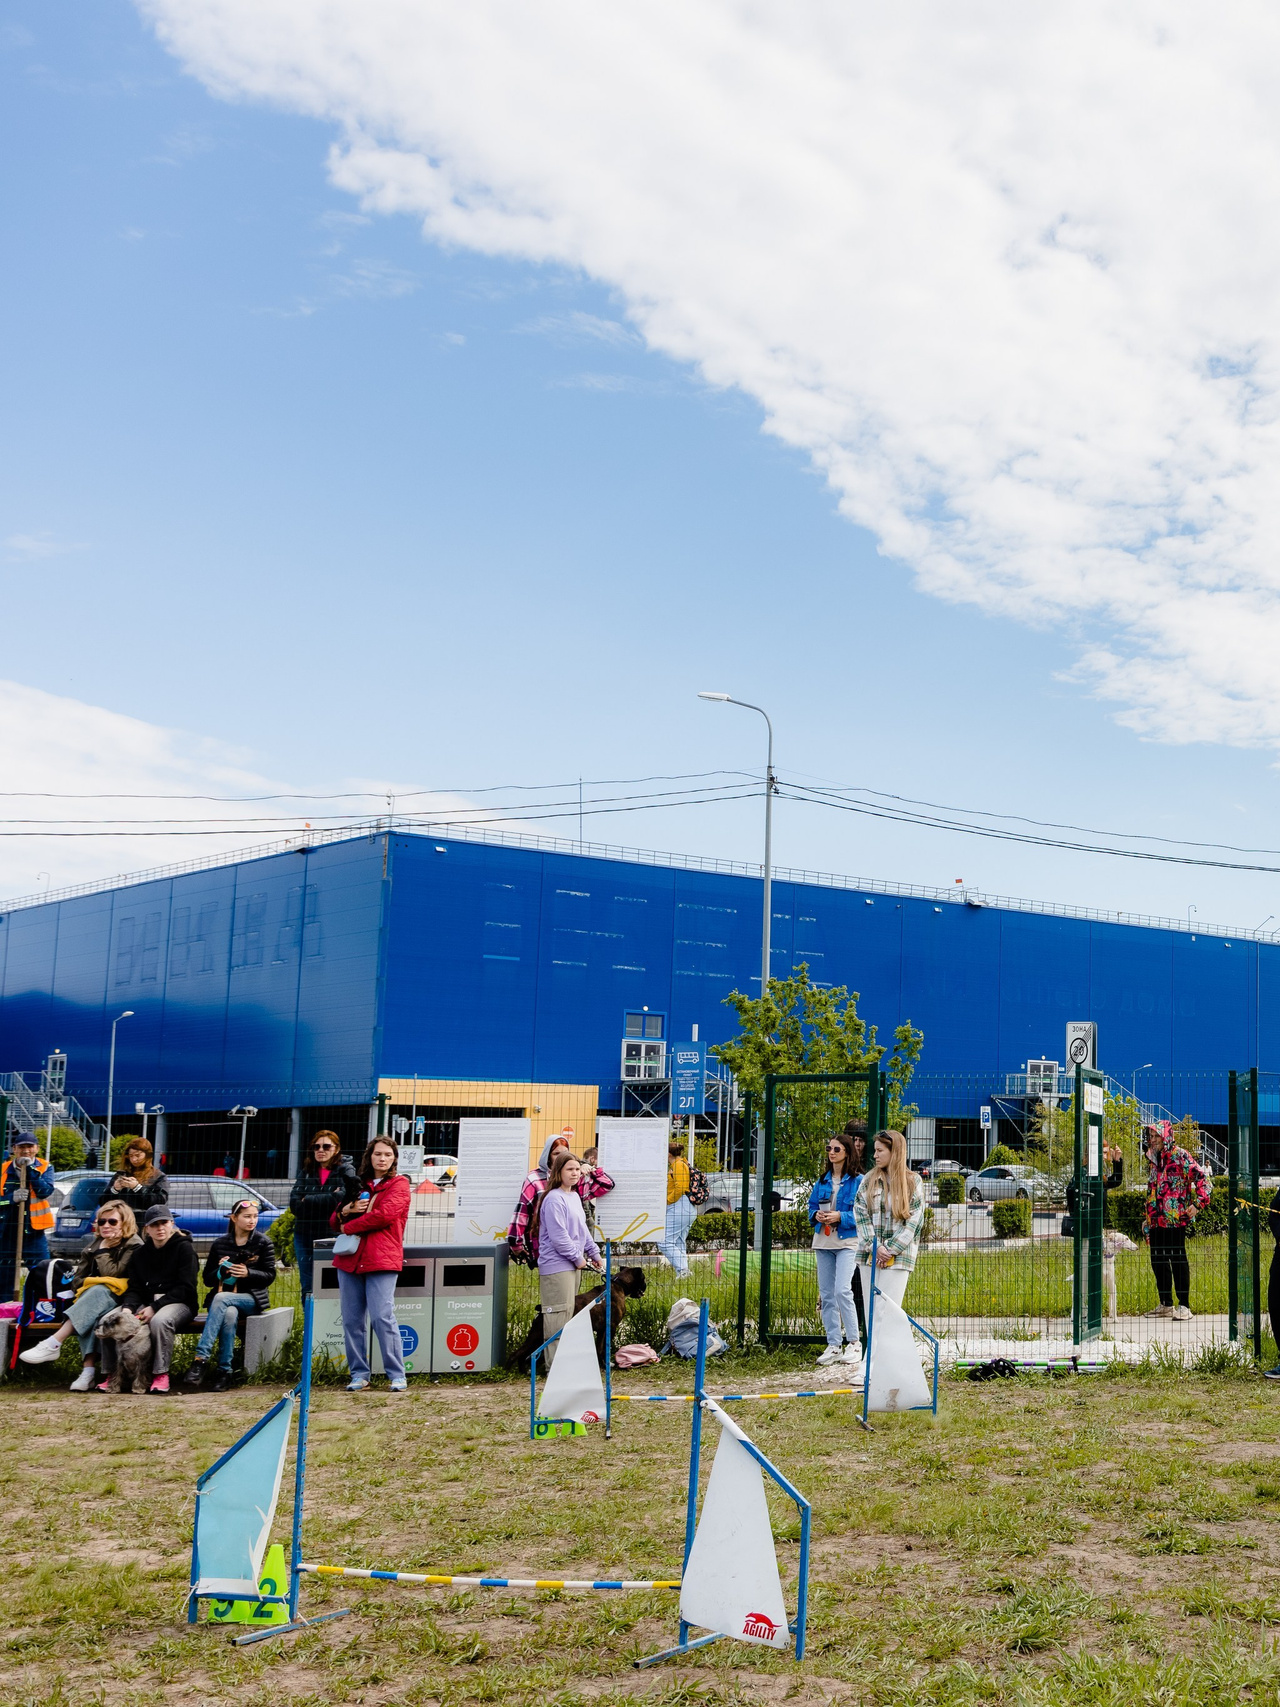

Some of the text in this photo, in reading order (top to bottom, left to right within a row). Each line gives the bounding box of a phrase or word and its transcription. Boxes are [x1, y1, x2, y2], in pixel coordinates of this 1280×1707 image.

[1072, 1025, 1087, 1033] ЗОНА
[1073, 1045, 1085, 1057] 20
[679, 1096, 695, 1108] 2Л
[393, 1303, 422, 1312] умага
[447, 1301, 483, 1310] Прочее
[253, 1578, 276, 1618] 2
[742, 1622, 777, 1641] AGILITY
